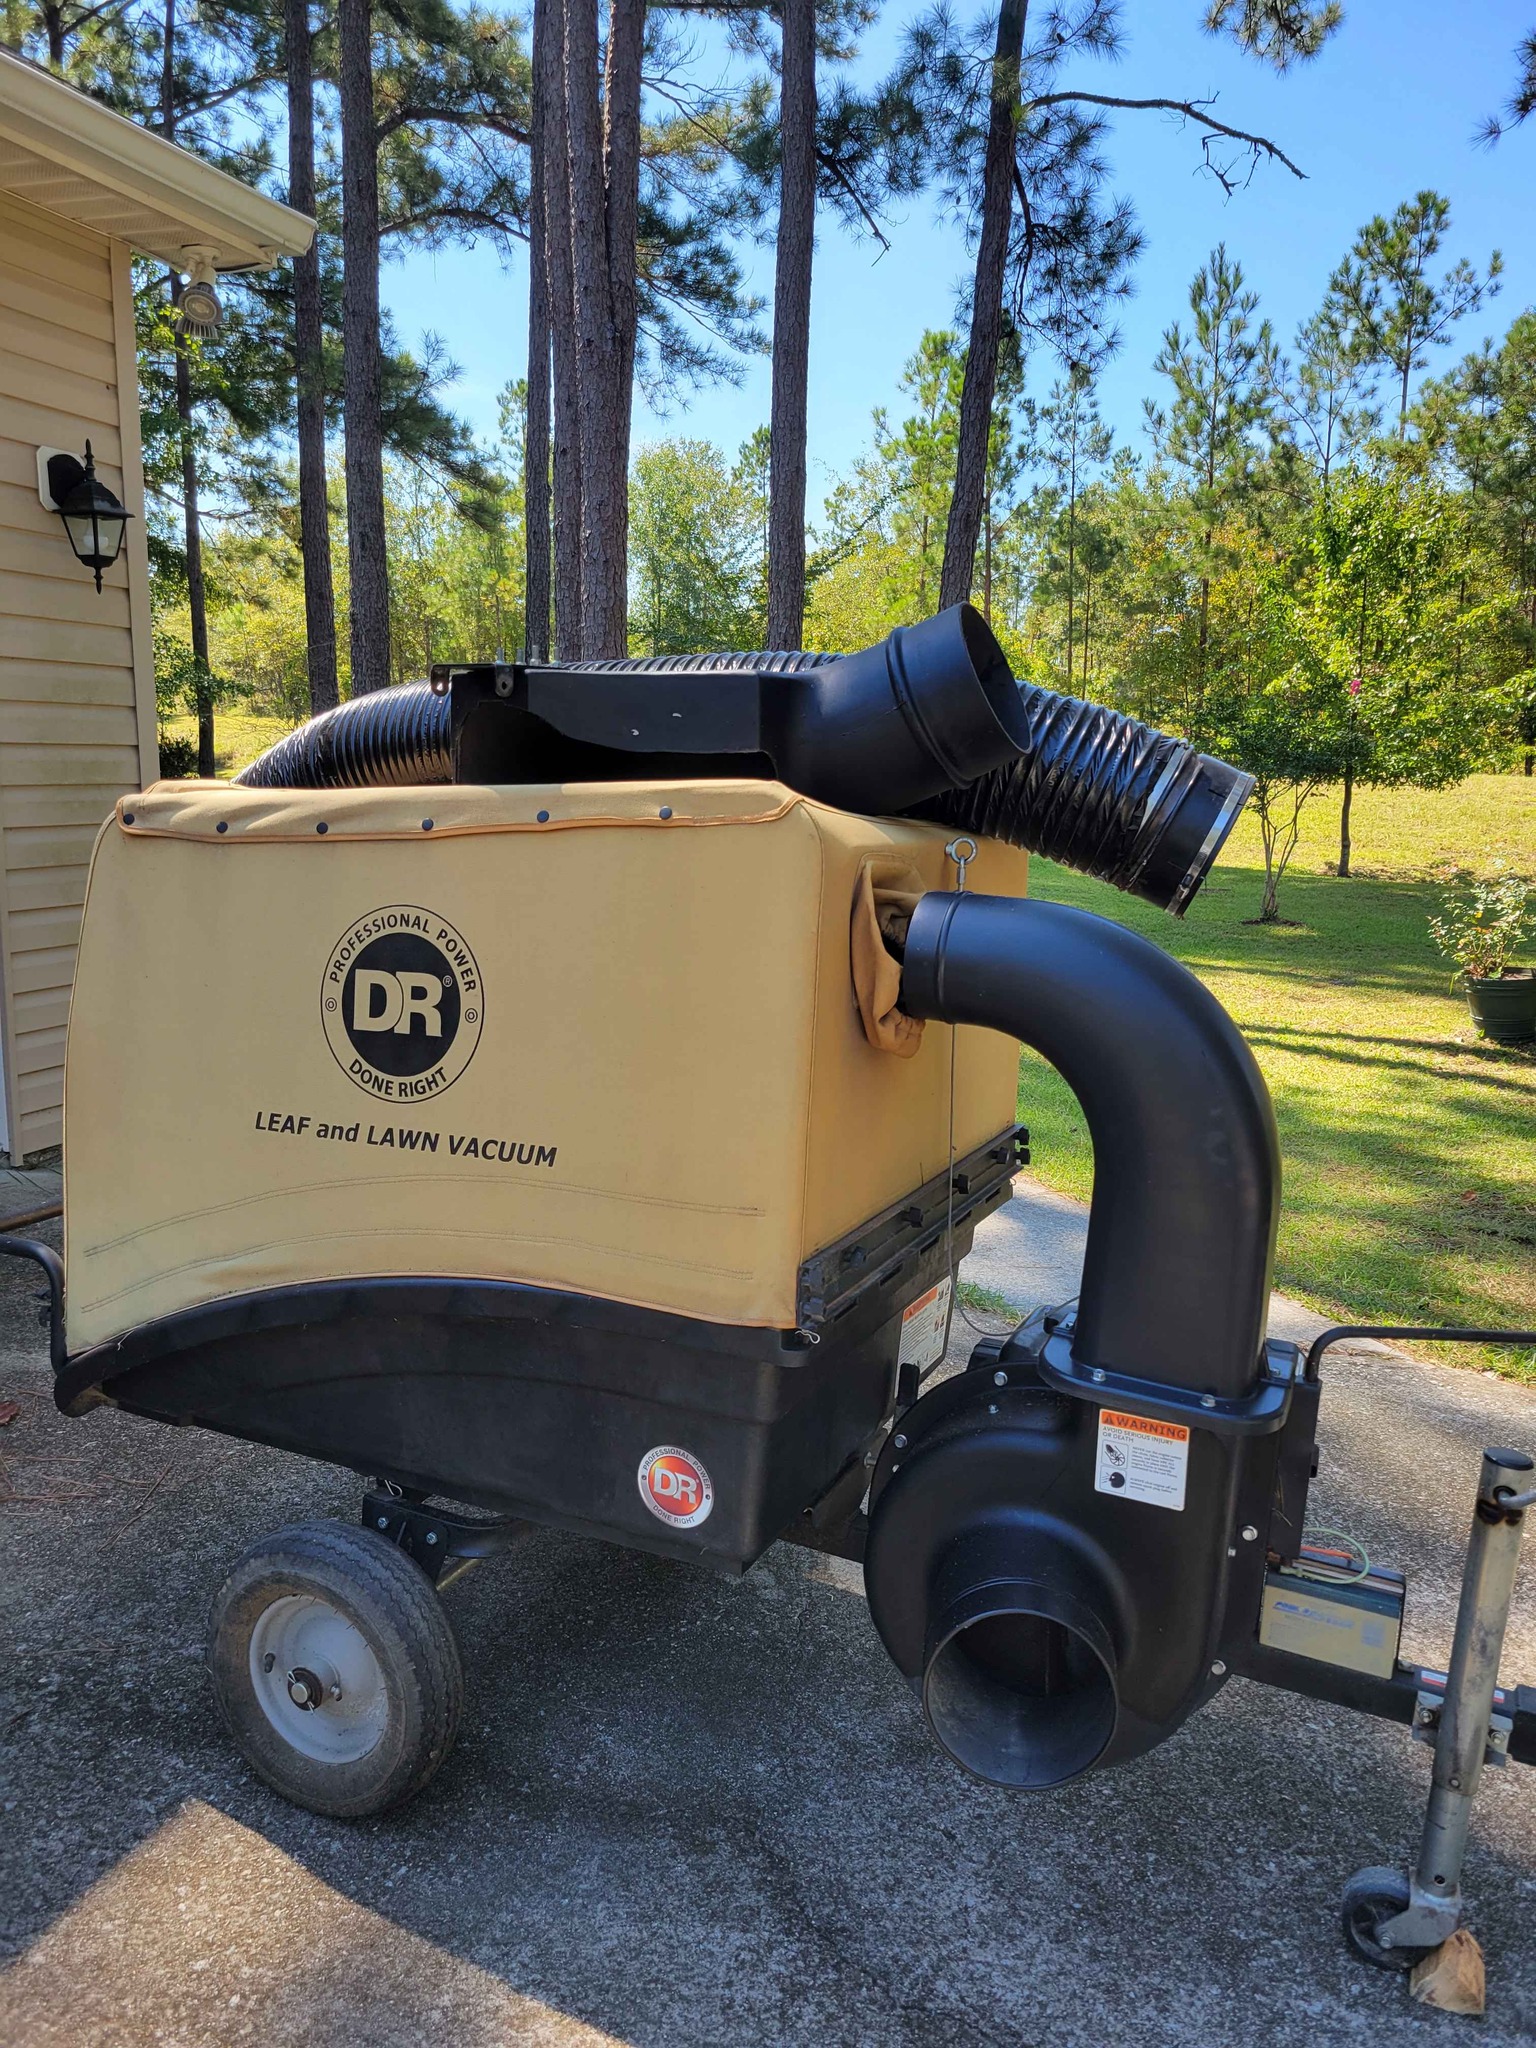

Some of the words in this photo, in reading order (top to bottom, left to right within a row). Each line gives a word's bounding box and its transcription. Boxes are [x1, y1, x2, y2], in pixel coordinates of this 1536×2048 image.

[329, 913, 430, 984] PROFESSIONAL
[436, 928, 477, 993] POWER
[349, 1058, 394, 1096] DONE
[398, 1066, 448, 1098] RIGHT
[255, 1111, 311, 1135] LEAF
[316, 1123, 360, 1143] and
[366, 1126, 440, 1152] LAWN
[448, 1135, 558, 1168] VACUUM
[1102, 1426, 1122, 1435] AVOID
[1124, 1430, 1151, 1440] SERIOUS
[1151, 1436, 1174, 1446] INJURY
[1112, 1433, 1134, 1443] DEATH
[1116, 1415, 1186, 1440] WARNING
[642, 1447, 690, 1471] PROFESSIONAL
[692, 1460, 711, 1490] POWER
[653, 1466, 698, 1505] DR
[653, 1504, 672, 1521] DONE
[673, 1515, 695, 1525] RIGHT
